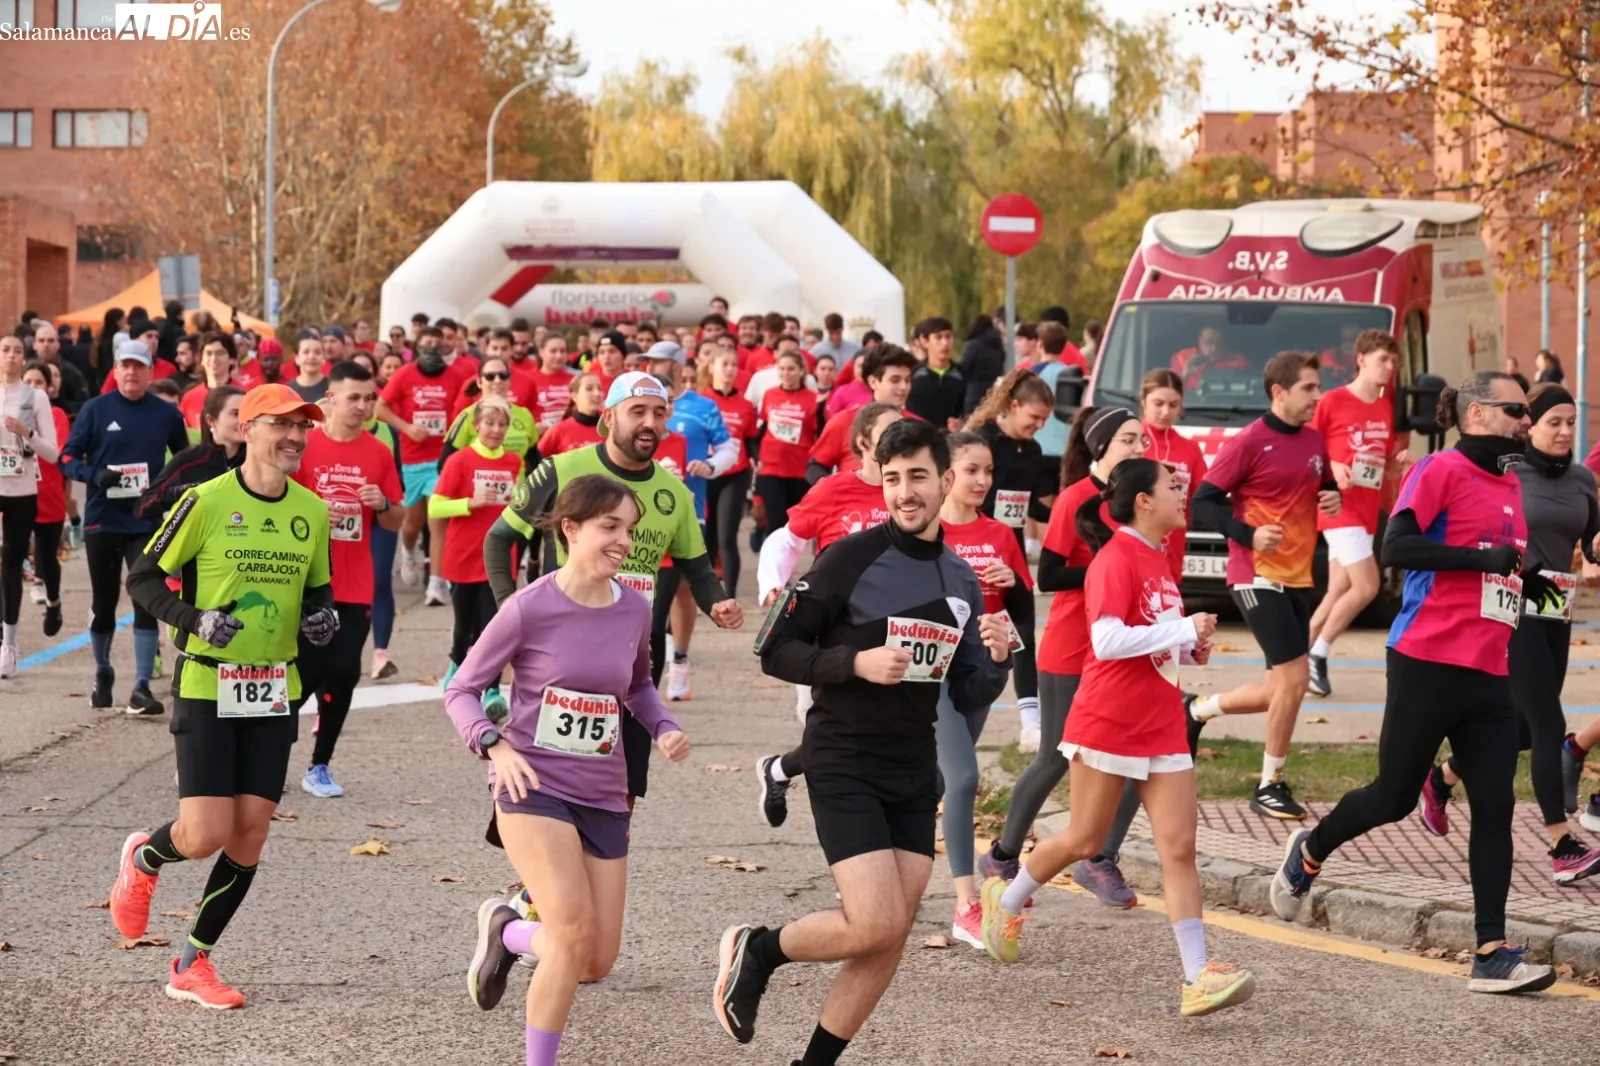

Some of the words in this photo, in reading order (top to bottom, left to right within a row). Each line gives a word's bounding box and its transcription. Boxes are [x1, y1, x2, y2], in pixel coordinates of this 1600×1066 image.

[1004, 503, 1025, 518] 232
[154, 496, 194, 552] CORRECAMINOS
[224, 549, 309, 565] CORRECAMINOS
[237, 562, 300, 576] CARBAJOSA
[244, 575, 291, 585] SALAMANCA
[1496, 589, 1519, 613] 175
[889, 621, 960, 645] bedunia
[220, 666, 286, 680] bedunia
[233, 682, 273, 703] 182
[545, 690, 617, 715] bedunia
[556, 712, 606, 741] 315
